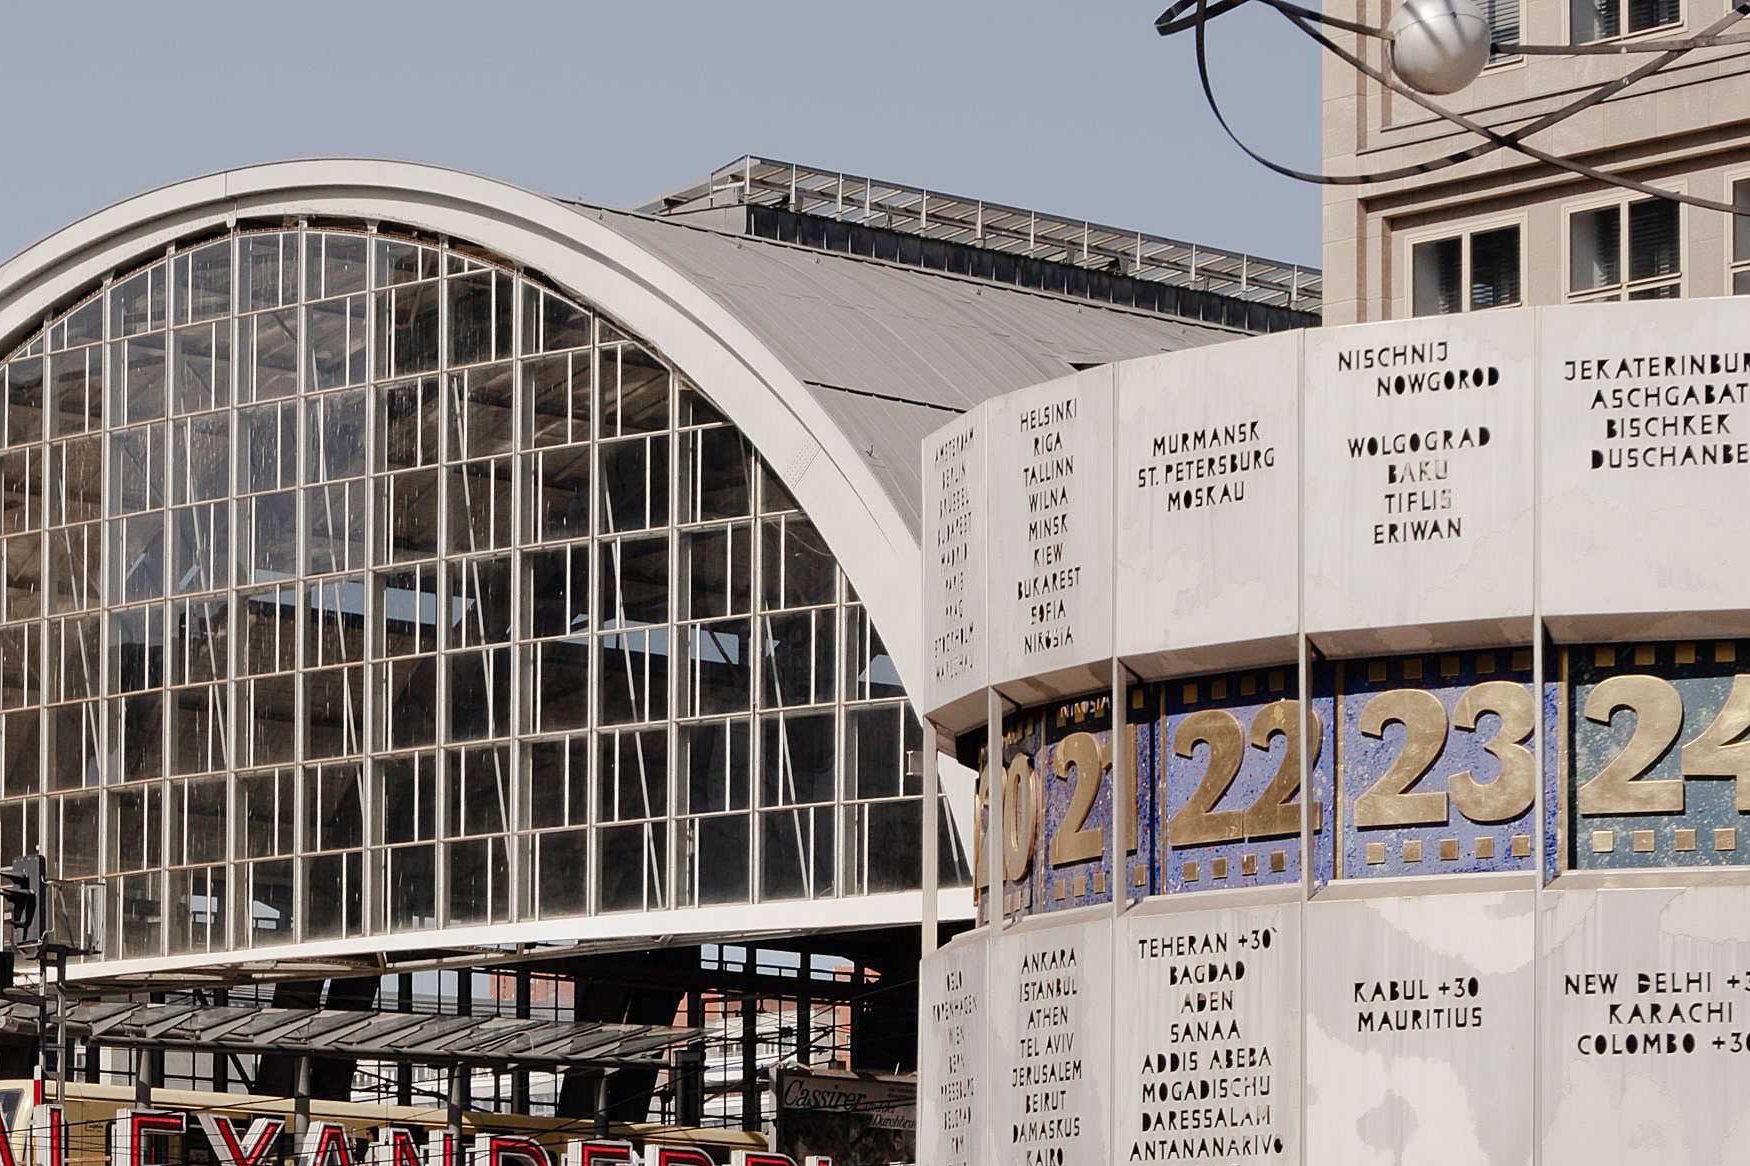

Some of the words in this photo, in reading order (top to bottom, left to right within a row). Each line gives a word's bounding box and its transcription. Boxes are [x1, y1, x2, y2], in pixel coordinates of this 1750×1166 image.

[1338, 342, 1448, 371] NISCHNIJ
[1377, 367, 1499, 396] NOWGOROD
[1591, 383, 1748, 409] ASCHGABAT
[1021, 398, 1077, 432] HELSINKI
[1606, 414, 1731, 438] BISCHKEK
[1034, 431, 1062, 456] RIGA
[1153, 421, 1260, 456] MURMANSK
[1348, 427, 1491, 457] WOLGOGRAD
[1138, 467, 1159, 487] ST.
[1165, 447, 1275, 483] PETERSBURG
[1591, 444, 1748, 469] DUSCHANBE
[1024, 456, 1074, 487] TALLINN
[1387, 461, 1449, 484] BAKU
[1029, 486, 1068, 512] WILNA
[1168, 481, 1245, 511] MOSKAU
[1384, 488, 1452, 513] TIFLIS
[1029, 513, 1068, 541] MINSK
[1374, 518, 1462, 544] ERIWAN
[1034, 543, 1063, 568] KIEW
[1018, 567, 1080, 600] BUKAREST
[1032, 600, 1066, 624] SOFIA
[1024, 626, 1073, 654] NIKOSIA
[1355, 680, 1535, 826] 23
[1169, 699, 1322, 846] 22
[1139, 932, 1228, 959] TEHERAN
[1021, 948, 1077, 975] ANKARA
[1170, 960, 1245, 985] BAGDAD
[1019, 976, 1077, 1002] ISTANBUL
[1354, 978, 1428, 1003] KABUL
[1438, 977, 1480, 999] +30
[1565, 973, 1619, 995] NEW
[1637, 971, 1712, 994] DELHI
[1181, 990, 1233, 1013] ADEN
[1609, 1002, 1733, 1025] KARACHI
[1028, 1006, 1068, 1030] ATHEN
[1171, 1019, 1241, 1043] SANAA
[1358, 1007, 1482, 1032] MAURITIUS
[1021, 1038, 1039, 1058] TEL
[1045, 1032, 1074, 1055] AVIV
[1578, 1033, 1695, 1055] COLOMBO
[1142, 1051, 1198, 1074] ADDIS
[1210, 1047, 1272, 1069] ABEBA
[1012, 1060, 1082, 1088] JERUSALEM
[784, 1078, 867, 1112] Cassirer
[1142, 1075, 1271, 1103] MOGADISCHU
[1026, 1091, 1066, 1114] BEIRUT
[1013, 1117, 1080, 1144] DAMASKUS
[1142, 1105, 1271, 1131] DARESSALAM
[1129, 1134, 1283, 1162] ANTANANARIVO
